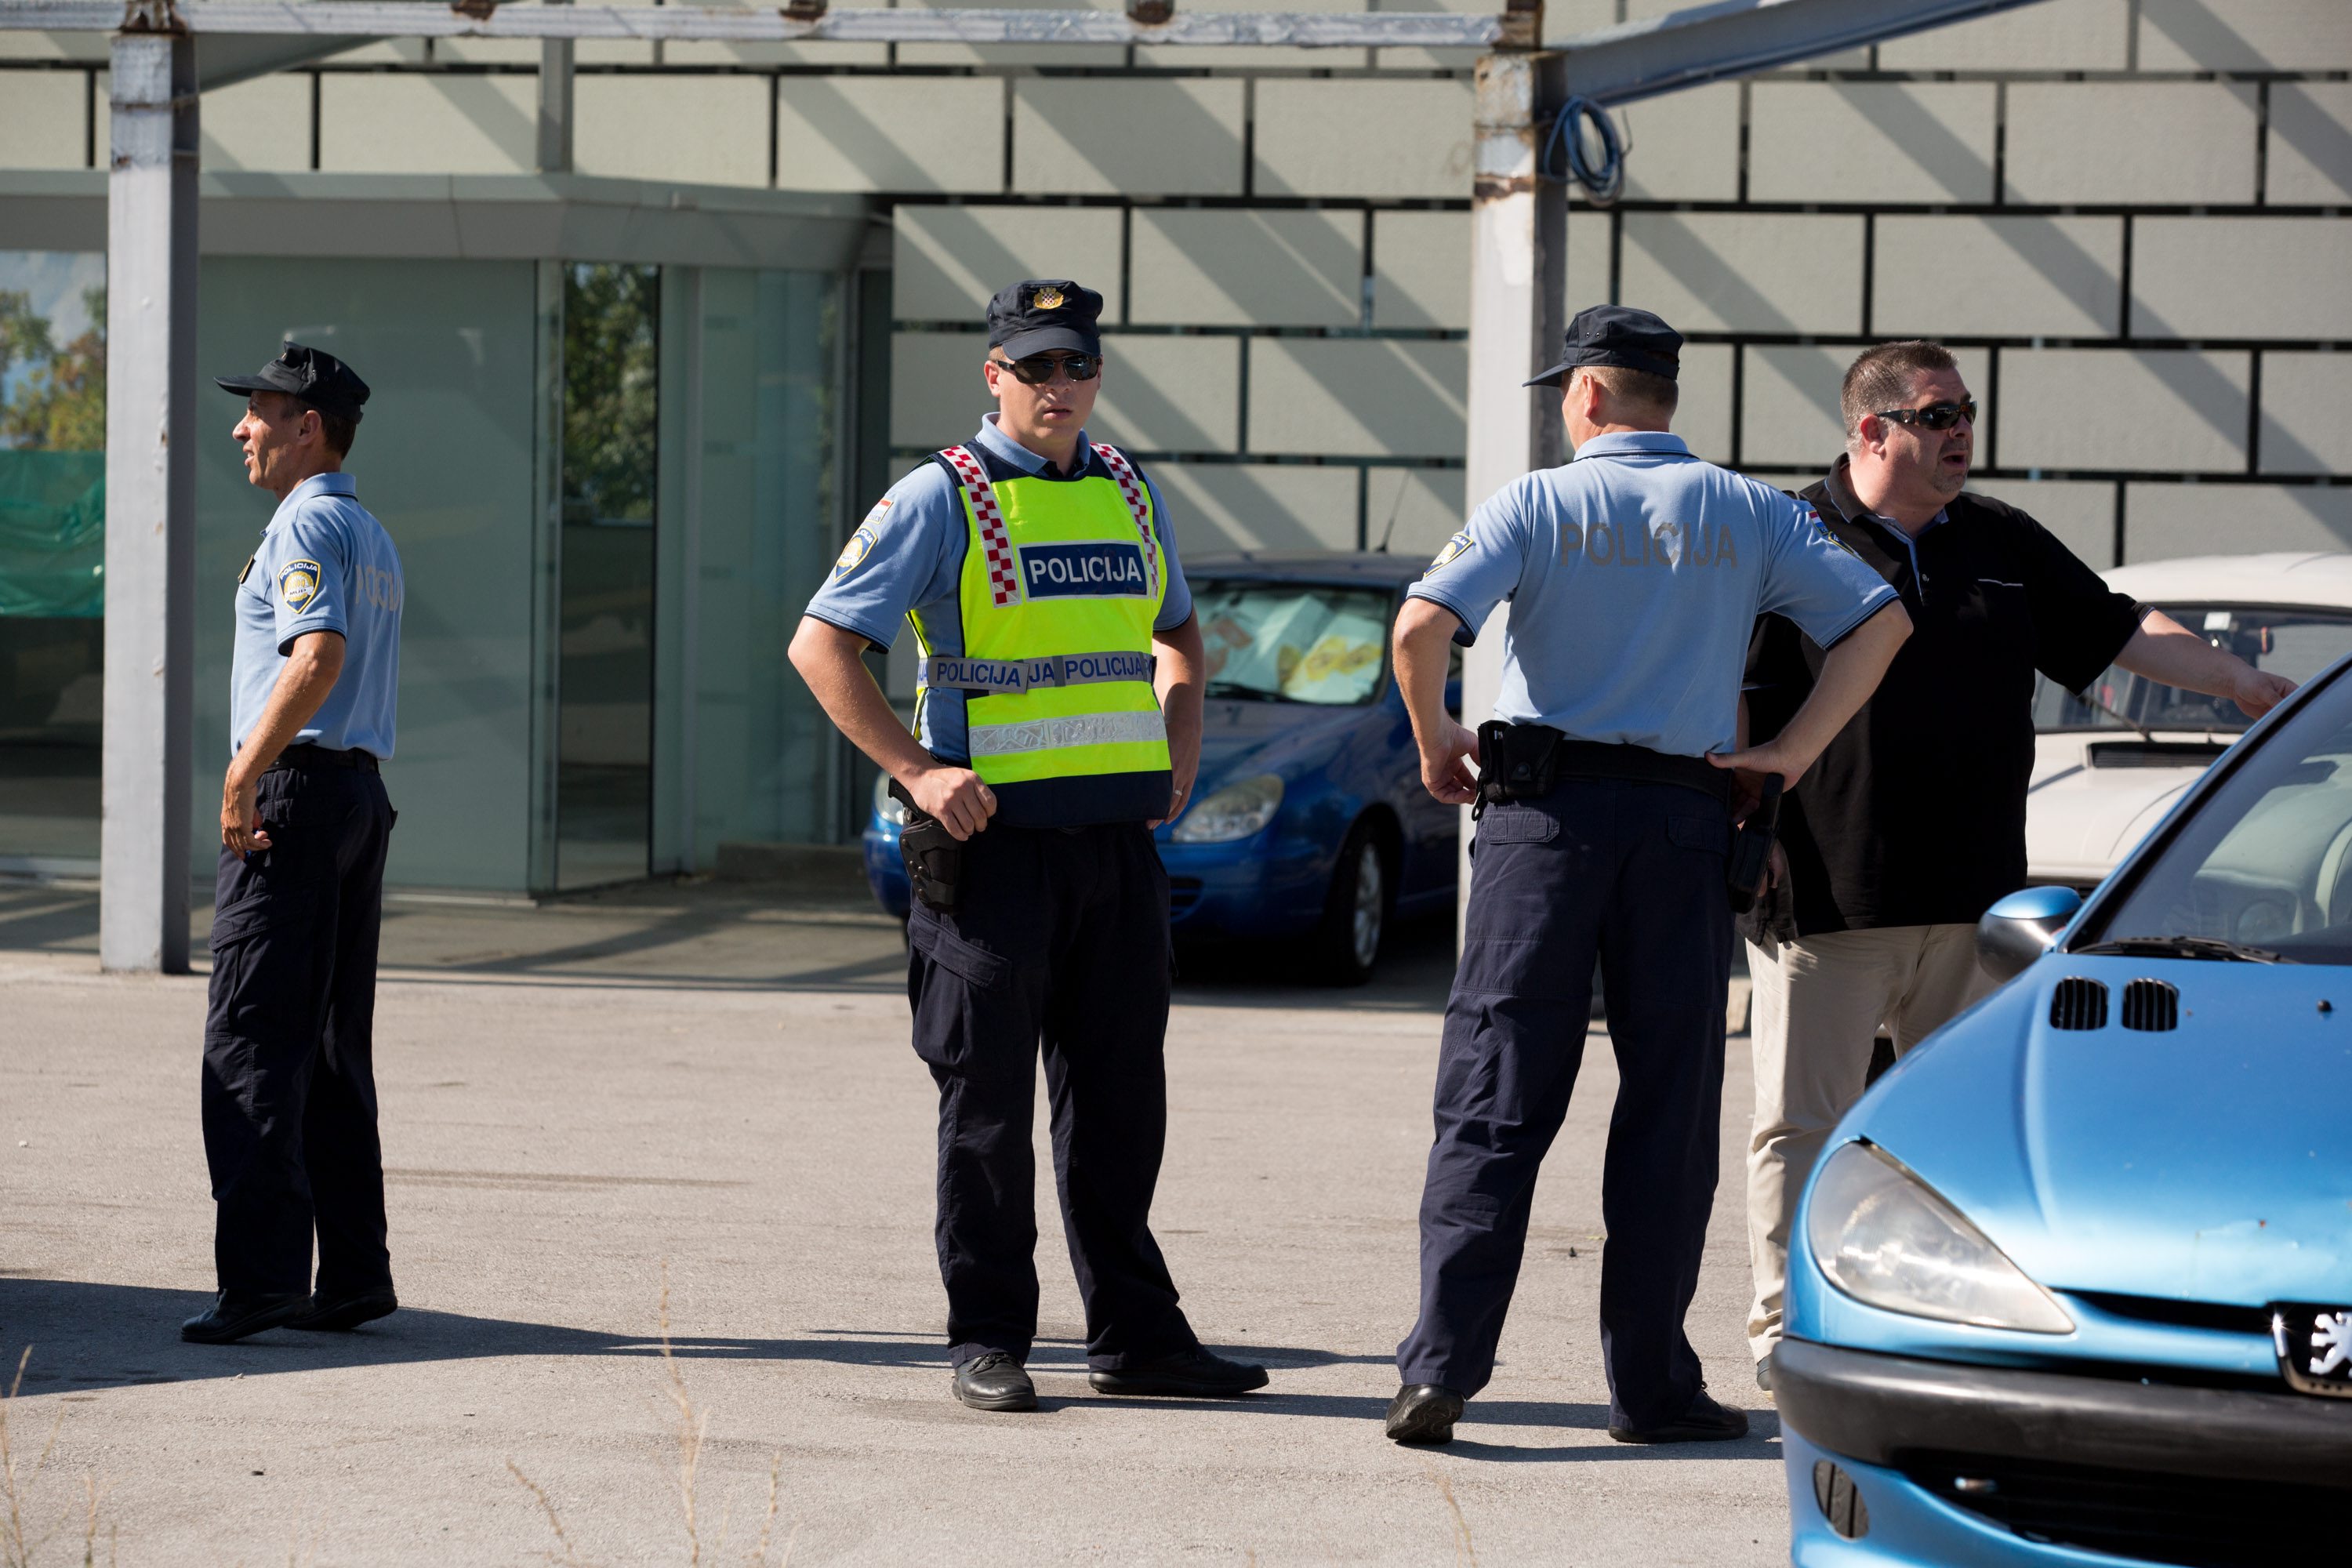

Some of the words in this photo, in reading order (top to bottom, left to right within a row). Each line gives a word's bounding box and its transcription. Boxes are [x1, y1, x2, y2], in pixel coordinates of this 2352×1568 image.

[1560, 522, 1738, 569] POLICIJA
[279, 562, 318, 580] POLICIJA
[1029, 556, 1142, 584] POLICIJA
[937, 662, 1021, 688] POLICIJA
[1065, 656, 1143, 680] POLICIJA
